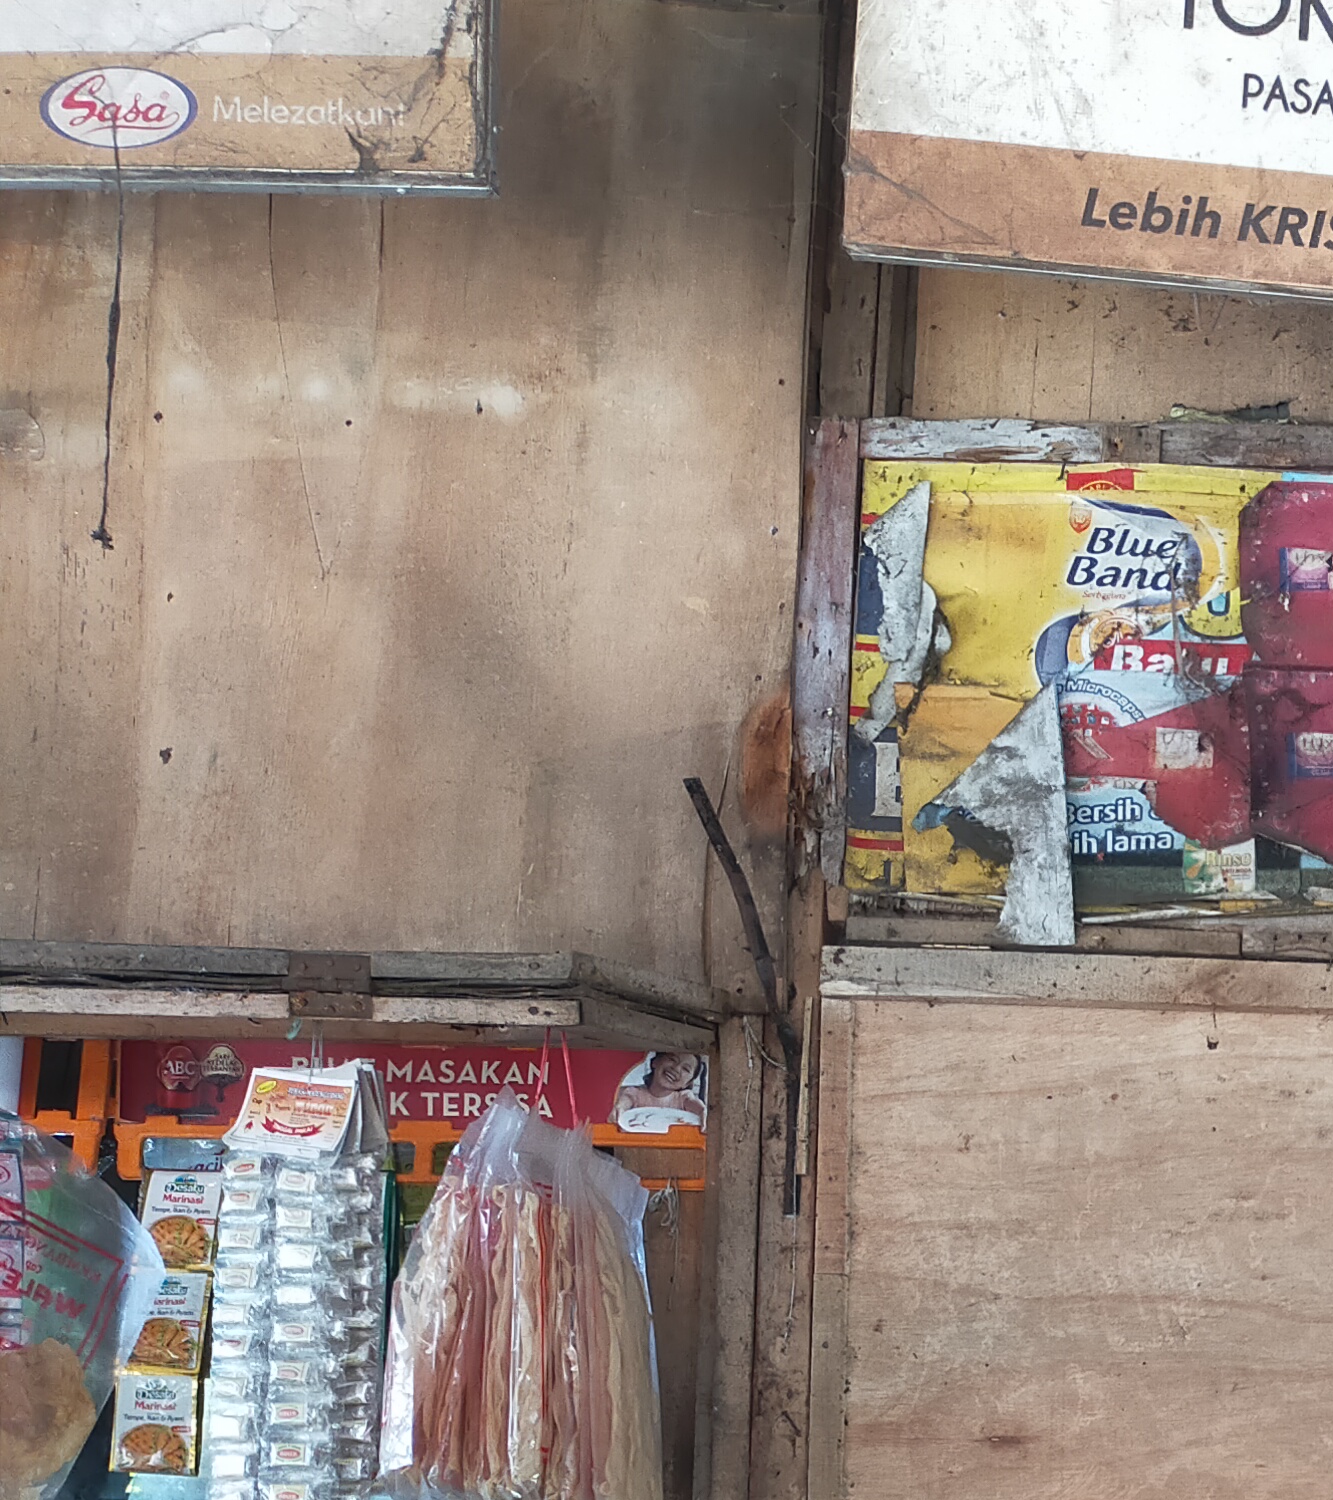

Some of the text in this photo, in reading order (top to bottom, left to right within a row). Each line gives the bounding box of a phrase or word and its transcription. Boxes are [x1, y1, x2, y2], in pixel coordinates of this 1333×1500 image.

[60, 74, 180, 132] Sasa
[1081, 187, 1222, 240] Lebih
[1086, 527, 1181, 560] Blue
[1066, 555, 1182, 592] Band
[1106, 830, 1173, 853] lama
[166, 1060, 196, 1076] ABC
[386, 1058, 549, 1086] MASAKAN
[420, 1092, 553, 1119] TERSSA
[163, 1193, 204, 1204] Marinasi
